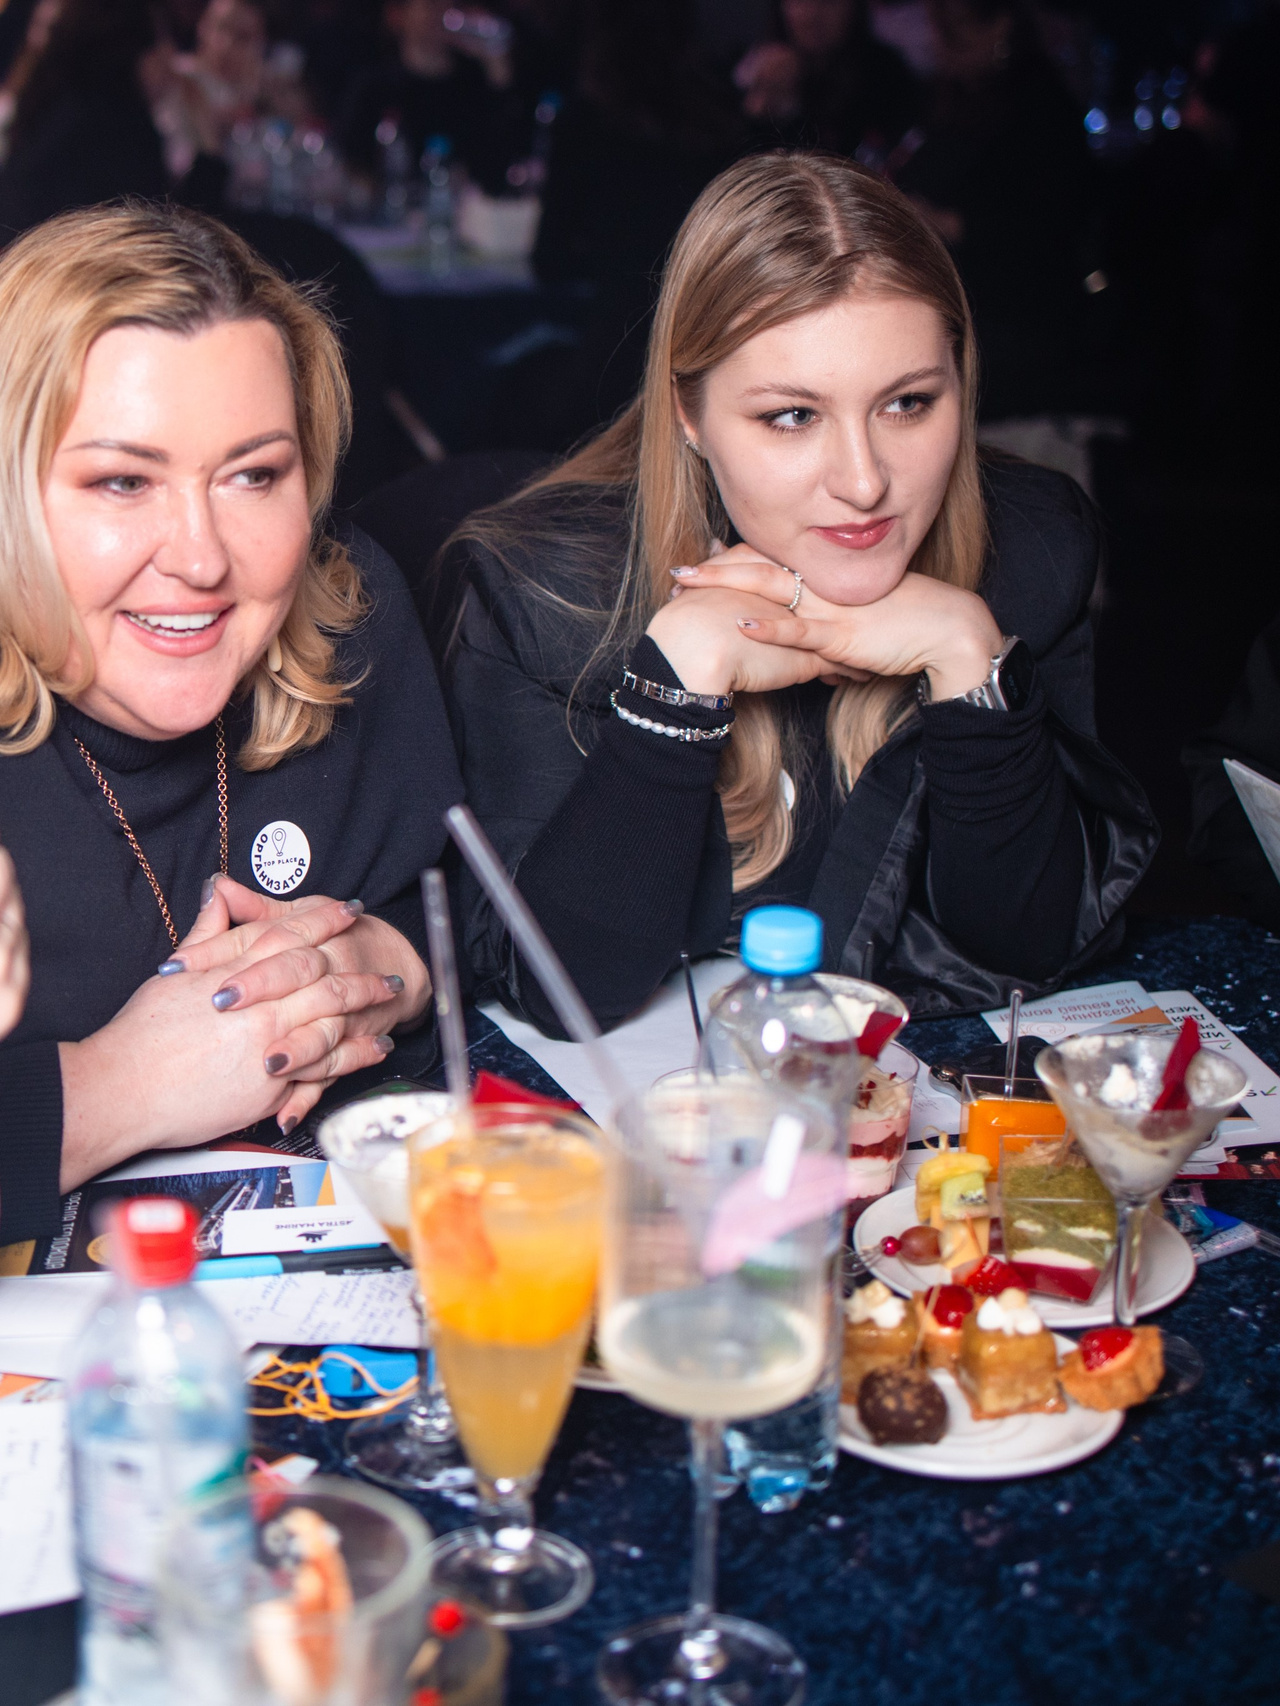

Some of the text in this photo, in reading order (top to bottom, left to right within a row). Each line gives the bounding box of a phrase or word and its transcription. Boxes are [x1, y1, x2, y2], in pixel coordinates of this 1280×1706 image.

[254, 833, 306, 891] ОРГАНИЗАТОР
[1058, 1000, 1111, 1014] вашей
[1116, 997, 1136, 1006] на
[1061, 1005, 1145, 1022] Праздник
[1162, 1006, 1199, 1014] МЕР
[318, 1219, 354, 1228] ASTRA
